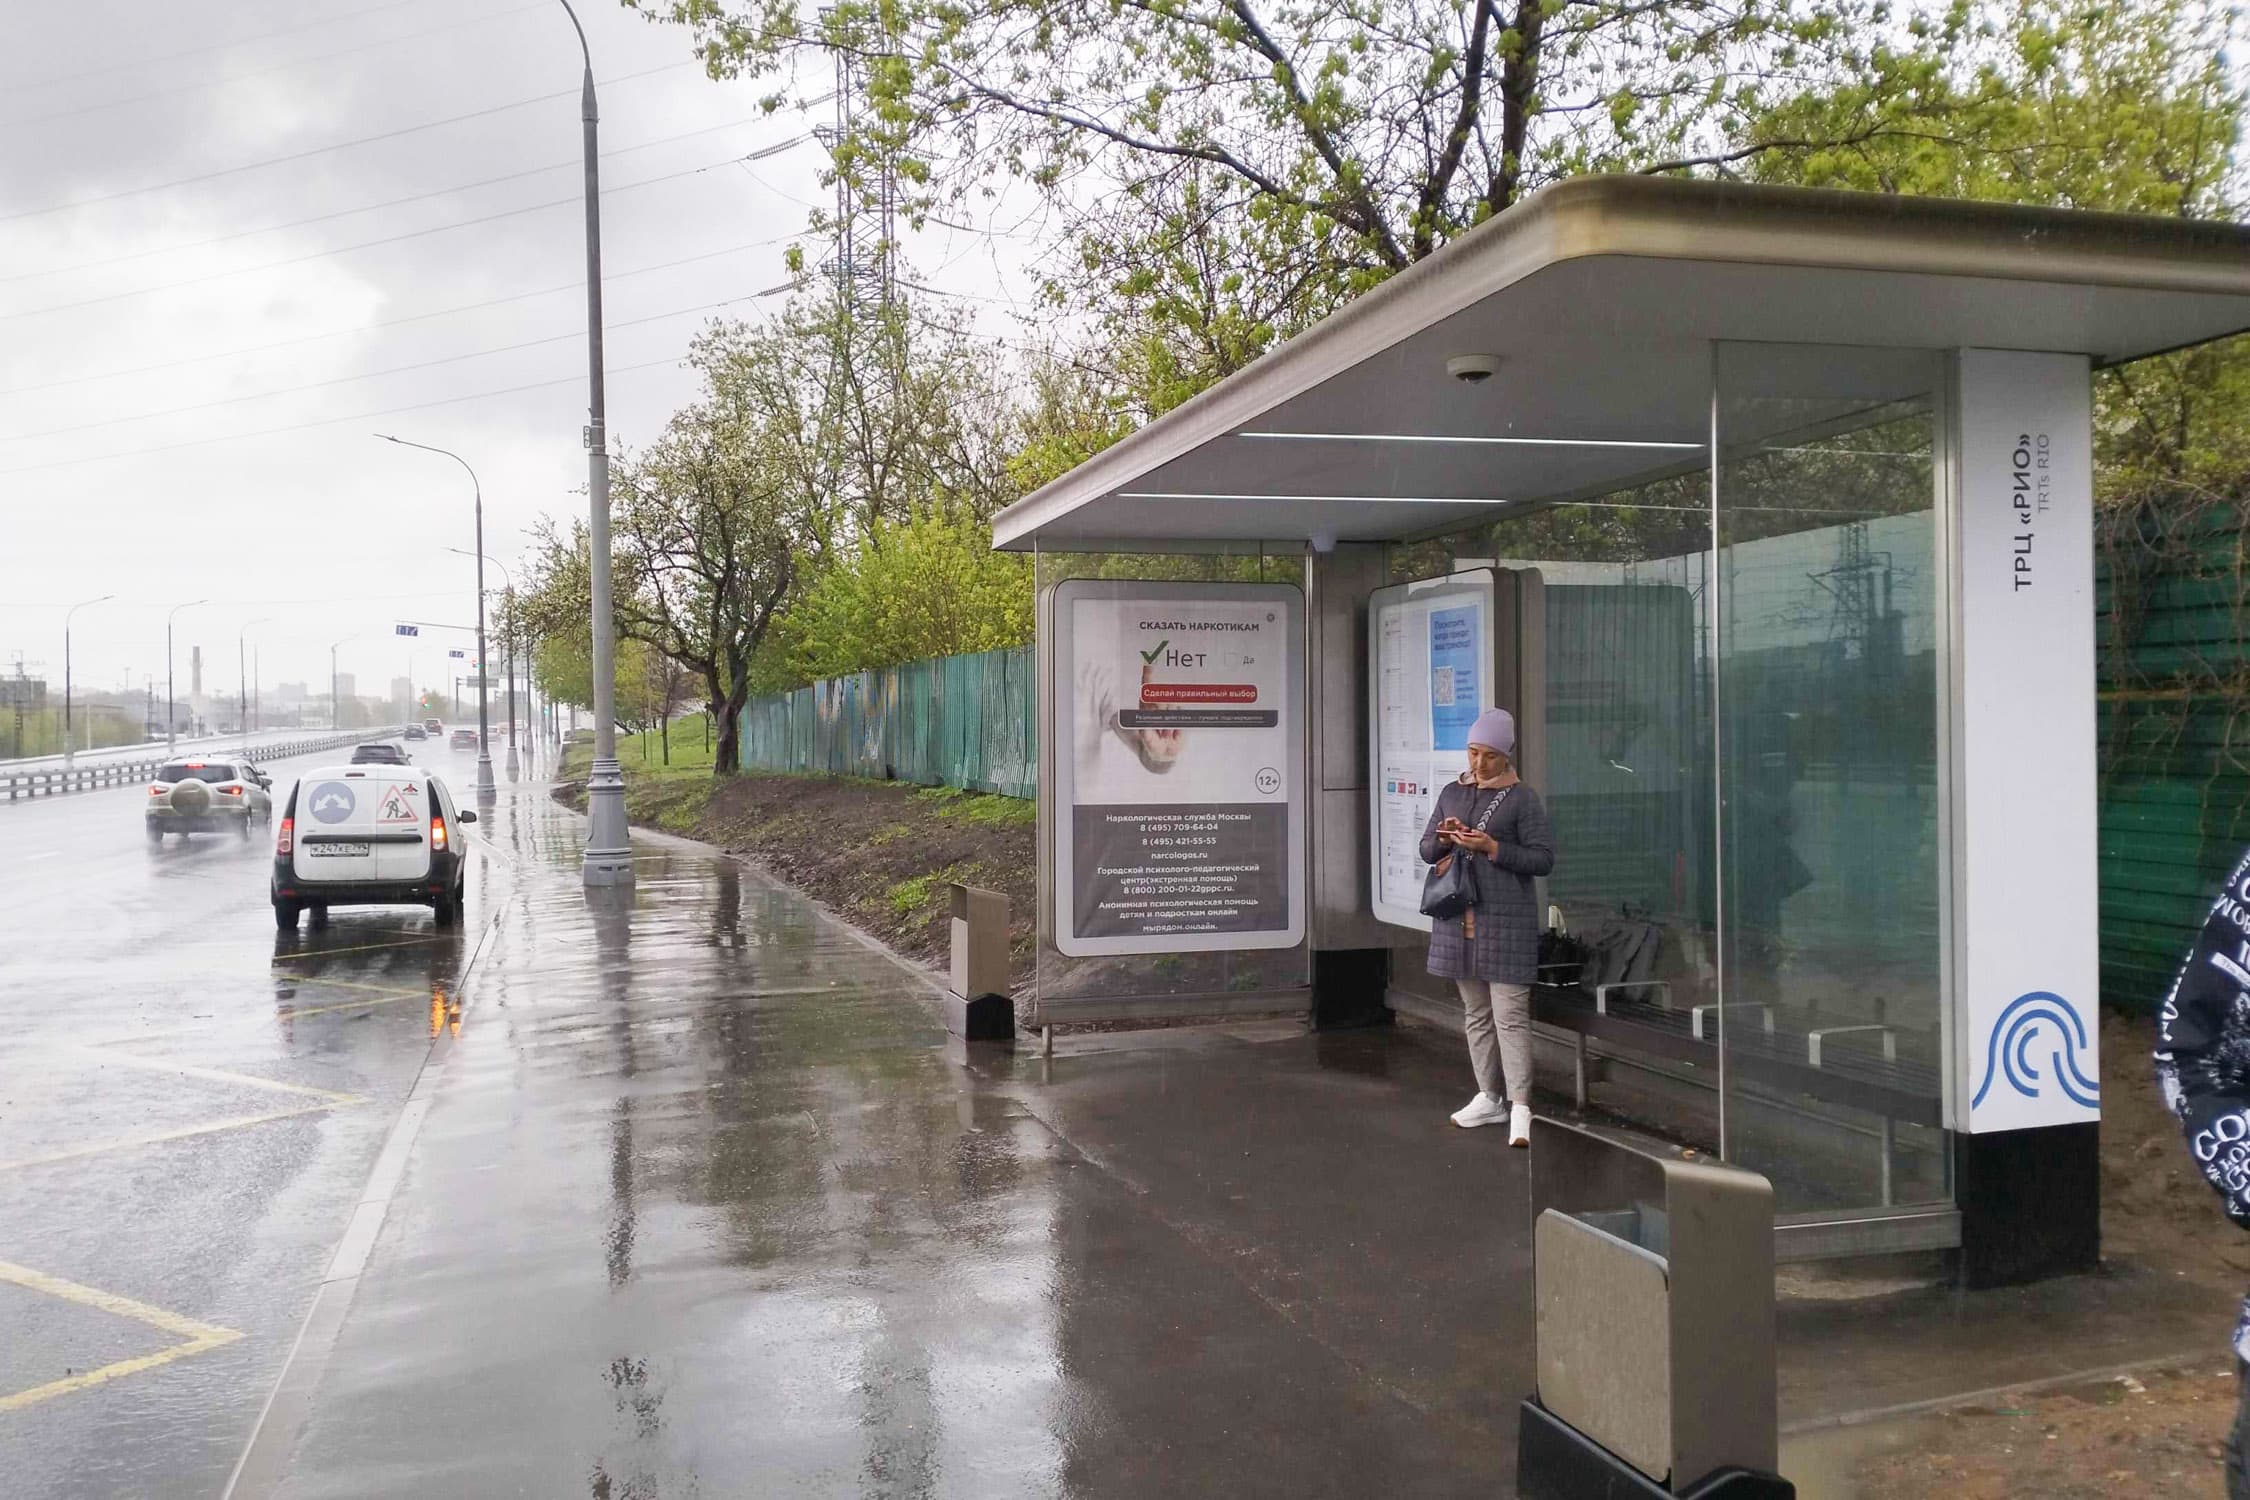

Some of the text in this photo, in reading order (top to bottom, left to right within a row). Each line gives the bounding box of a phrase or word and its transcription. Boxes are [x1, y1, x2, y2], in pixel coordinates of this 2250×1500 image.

[2036, 434, 2050, 514] TRTs RIO
[2012, 433, 2035, 592] ТРЦ «РИО»
[1139, 621, 1260, 632] СКАЗАТЬ НАРКОТИКАМ
[1166, 650, 1255, 667] Нет Да
[1143, 689, 1256, 698] Сделай правильный выбор
[1259, 775, 1277, 786] 12+
[1106, 813, 1252, 823] Наркологическая служба Москвы
[1140, 823, 1218, 832] 8 (495) 709-64-04
[1142, 837, 1217, 846] 8 (495) 421-55-55
[1097, 866, 1143, 876] Городской
[1199, 875, 1238, 883] помощь)
[1123, 887, 1130, 895] 8
[1131, 886, 1156, 895] (800)
[1098, 902, 1148, 910] Анонимная
[1149, 900, 1223, 908] психологическая
[1154, 910, 1206, 918] подросткам
[1207, 908, 1239, 916] онлайн
